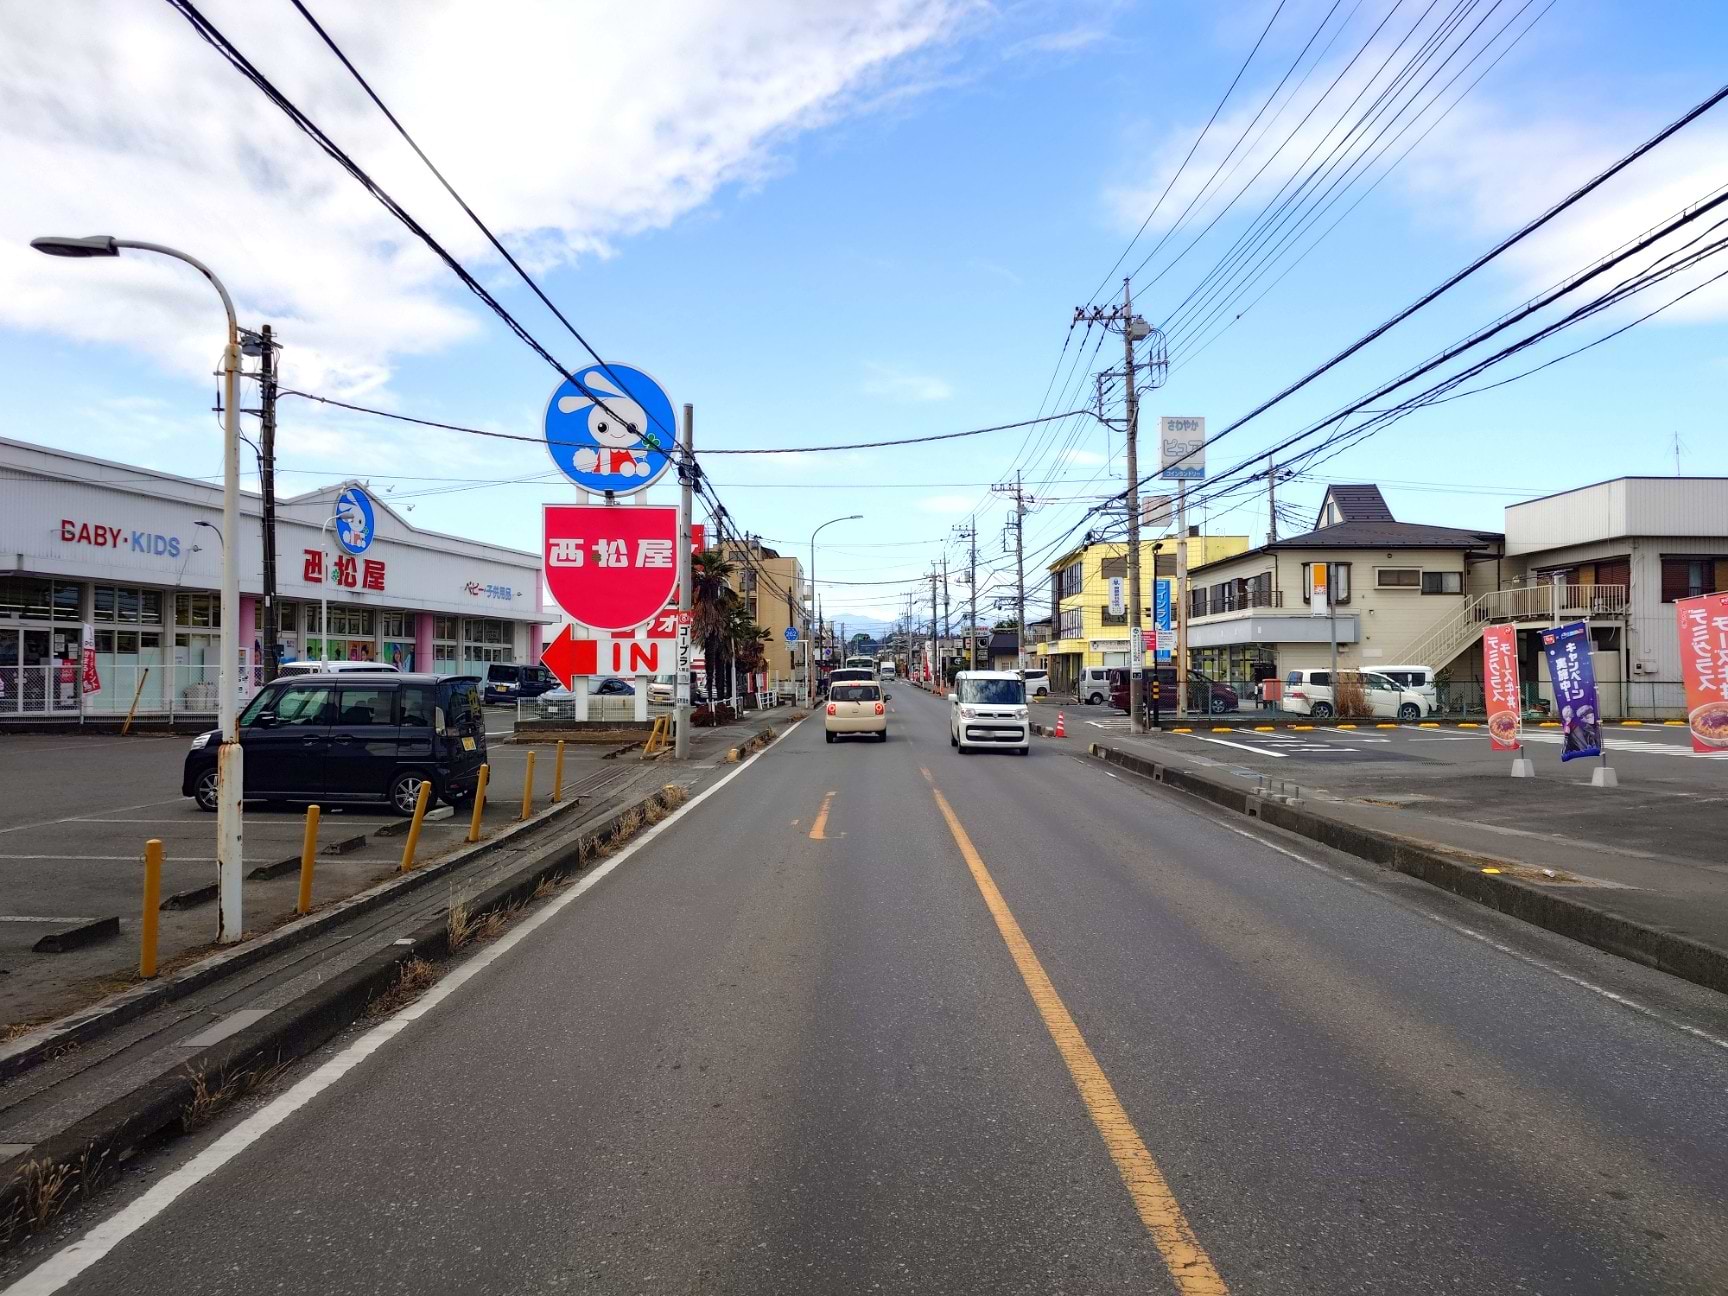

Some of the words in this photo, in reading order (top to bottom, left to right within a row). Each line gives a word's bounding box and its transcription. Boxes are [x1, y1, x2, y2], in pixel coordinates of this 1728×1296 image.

[1167, 419, 1199, 431] さわやか
[303, 548, 386, 592] 西松屋
[549, 538, 673, 568] 西松屋
[612, 642, 659, 672] IN
[679, 625, 690, 666] ゴープラ
[1565, 642, 1585, 700] キャンペーン
